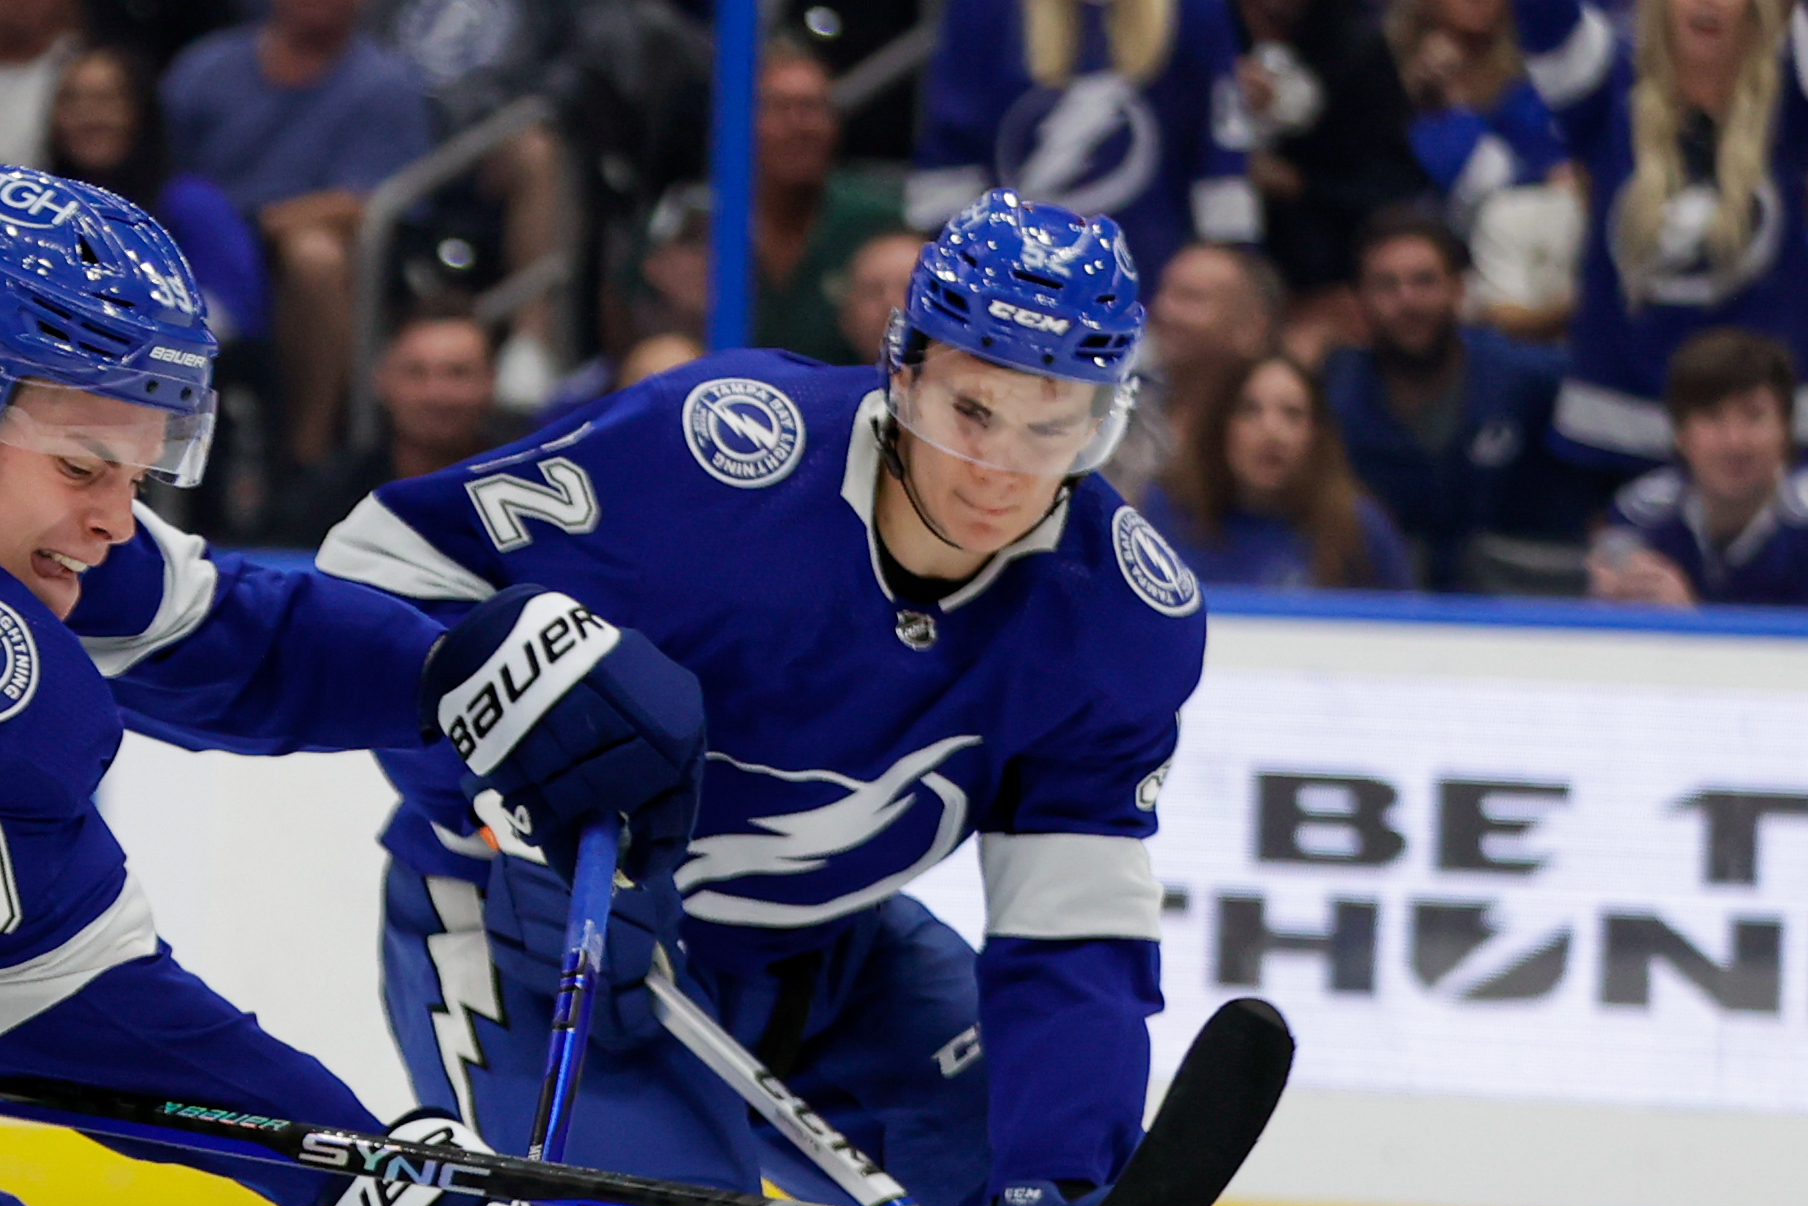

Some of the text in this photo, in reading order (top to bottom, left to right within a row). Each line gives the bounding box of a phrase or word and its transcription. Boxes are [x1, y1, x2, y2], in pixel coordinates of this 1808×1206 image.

[988, 300, 1071, 336] CCM
[149, 346, 208, 369] BAUER
[708, 382, 771, 401] TAMPA
[464, 421, 602, 553] 2
[448, 605, 606, 763] BAUER
[1252, 770, 1572, 876] BE
[1164, 888, 1808, 1020] HUN
[176, 1104, 291, 1132] BAUER
[297, 1132, 492, 1197] SYNC
